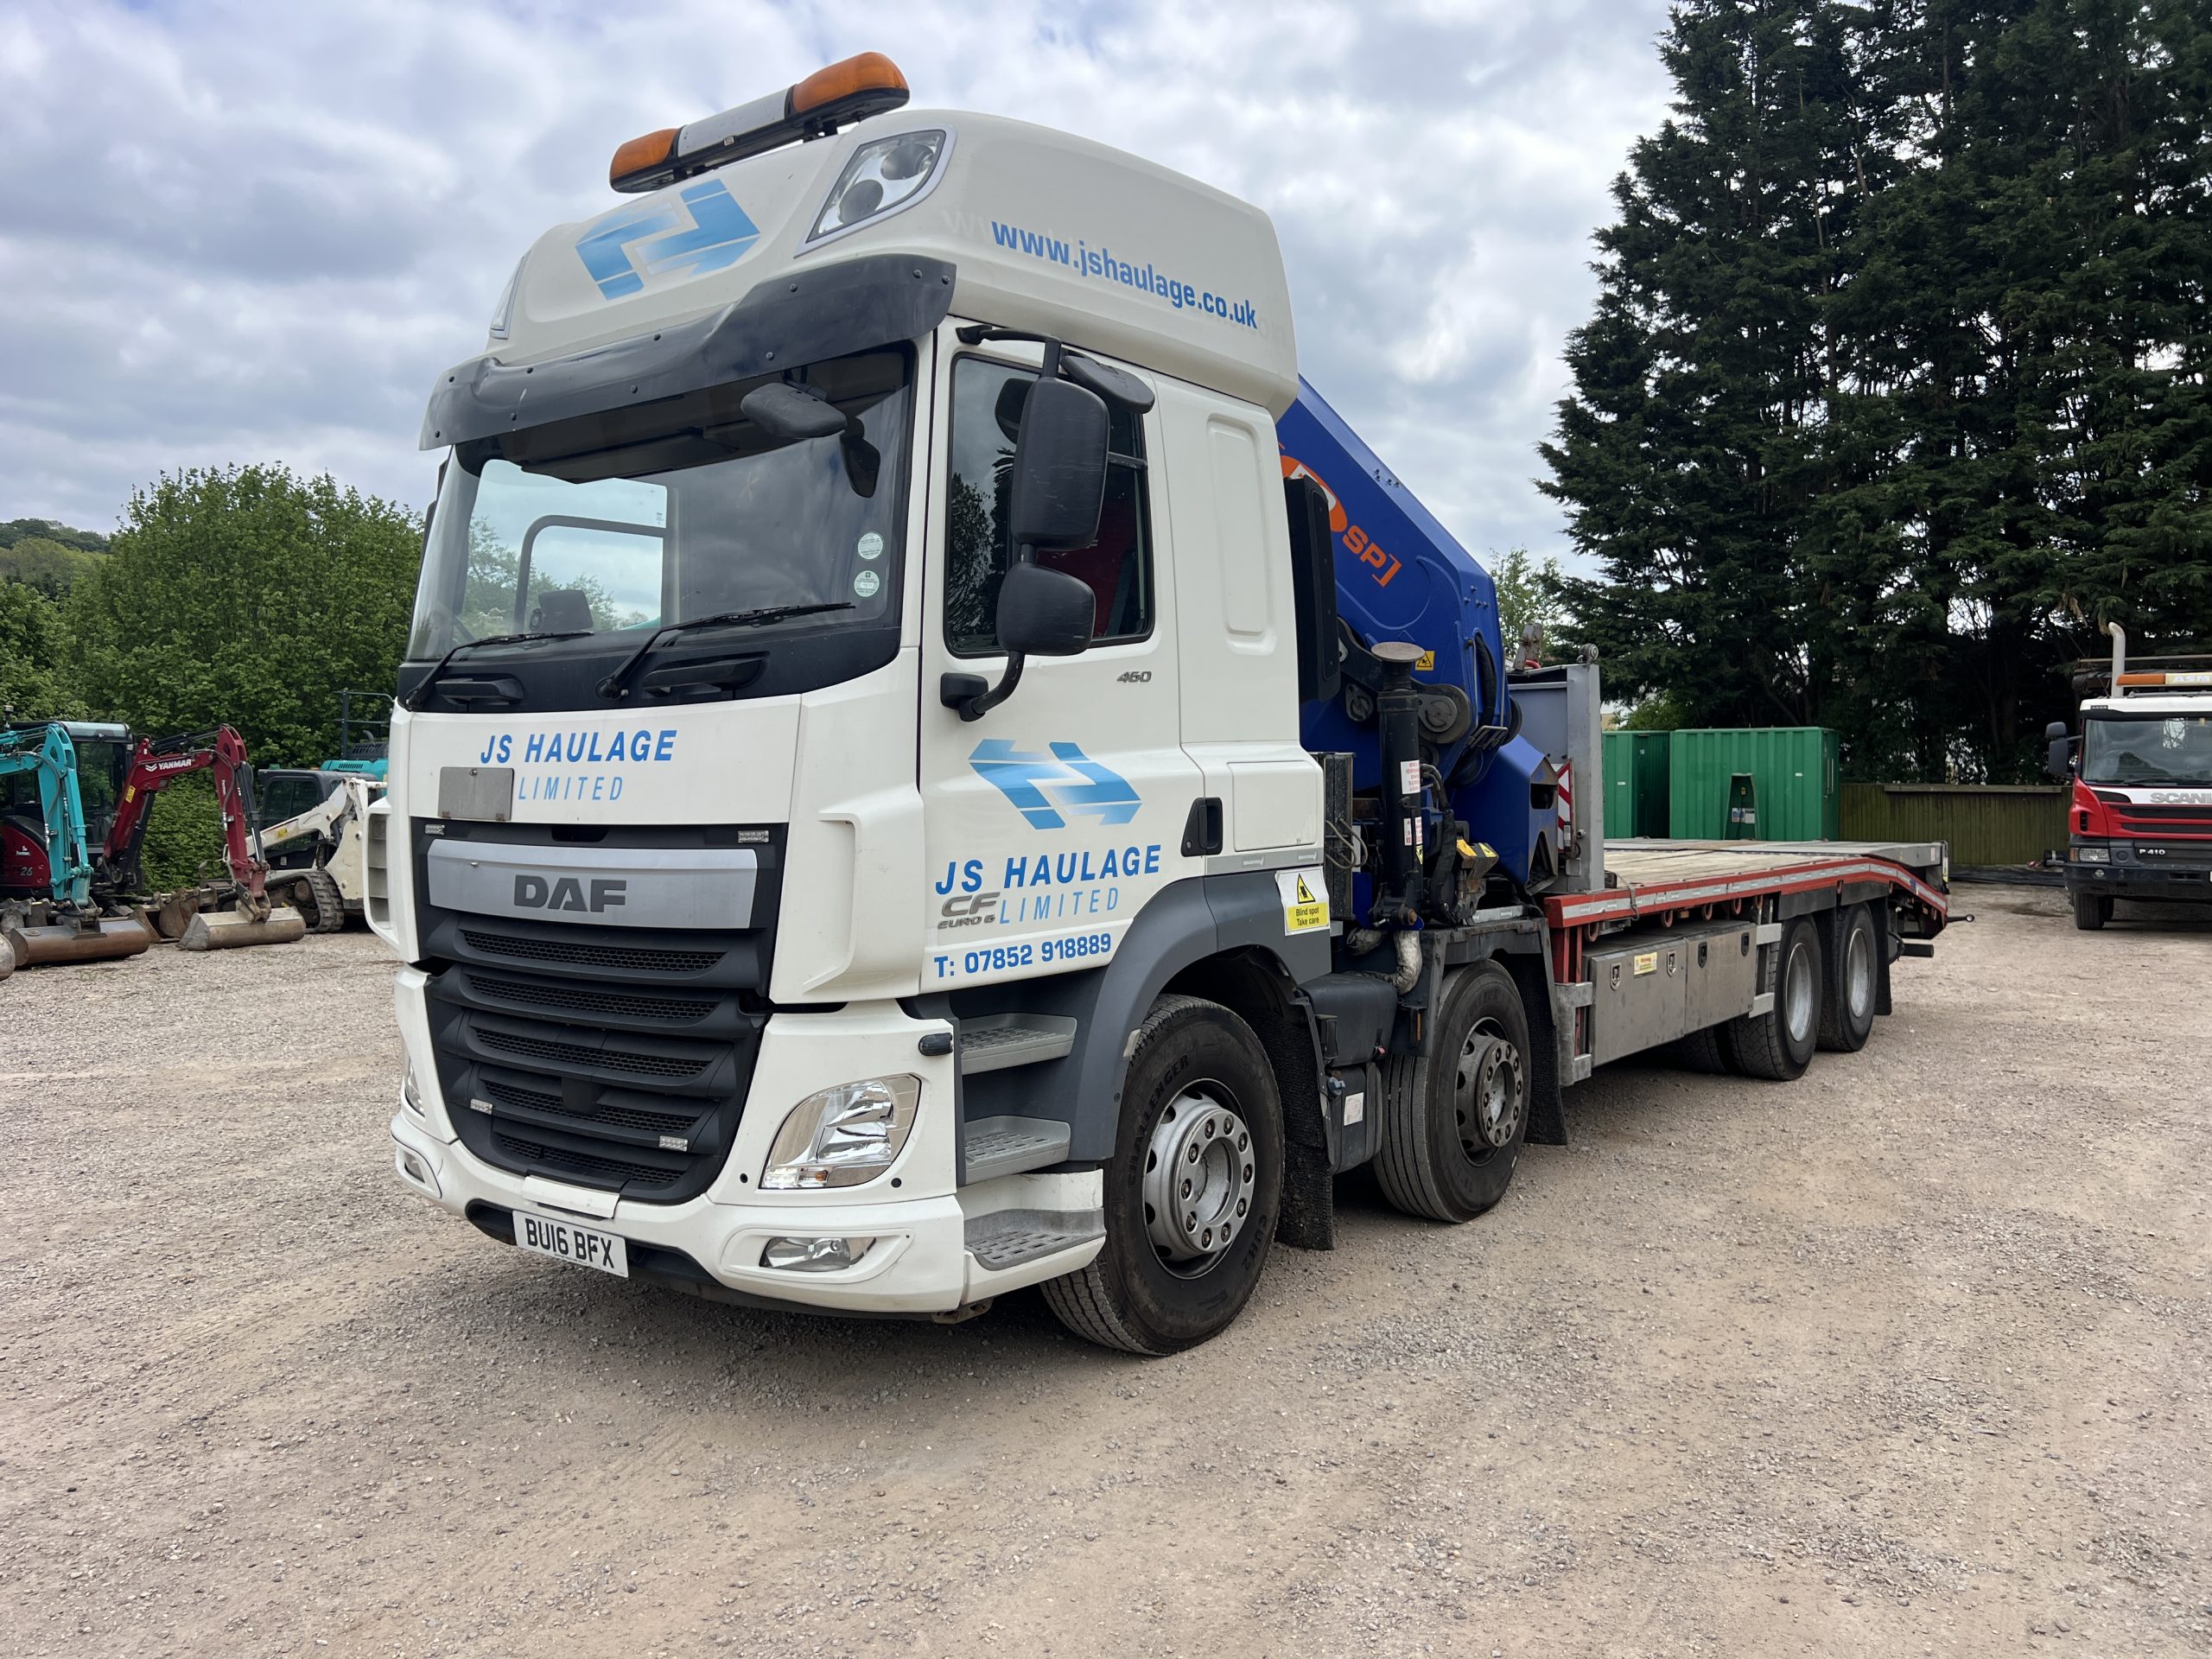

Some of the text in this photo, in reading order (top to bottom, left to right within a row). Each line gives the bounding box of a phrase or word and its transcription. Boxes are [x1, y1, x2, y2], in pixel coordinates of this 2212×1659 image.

[991, 221, 1258, 329] www.jshaulage.co.uk
[1116, 671, 1153, 683] 460
[480, 730, 677, 764] JS HAULAGE
[158, 759, 192, 771] YANMAR
[518, 777, 623, 800] LIMITED
[21, 867, 33, 876] 26
[935, 844, 1161, 895] JS HAULAGE
[514, 874, 626, 912] DAF
[941, 892, 1001, 917] CF
[1000, 887, 1118, 925] LIMITED
[938, 915, 995, 930] EURO 6
[1295, 906, 1319, 917] Blind spot
[934, 933, 1111, 978] T: 07852 918889
[1127, 1054, 1190, 1189] CHALLENGER
[524, 1217, 614, 1268] BU16 BFX
